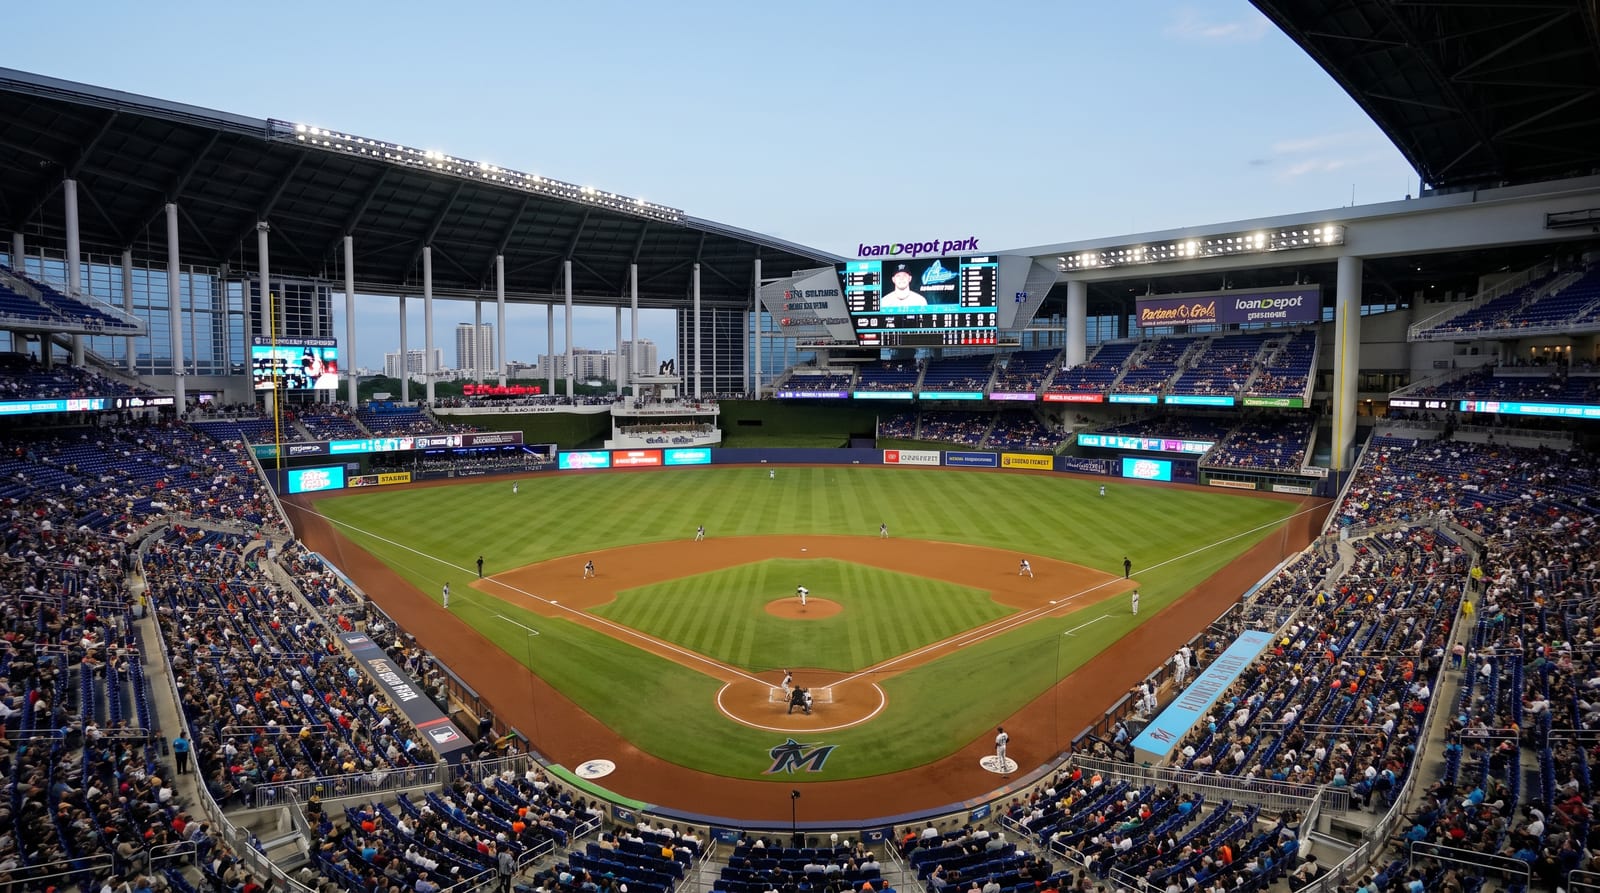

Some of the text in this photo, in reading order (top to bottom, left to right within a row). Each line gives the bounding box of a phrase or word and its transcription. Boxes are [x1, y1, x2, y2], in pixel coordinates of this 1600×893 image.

[857, 236, 979, 257] loanDepot park
[1235, 295, 1303, 310] loanDepot
